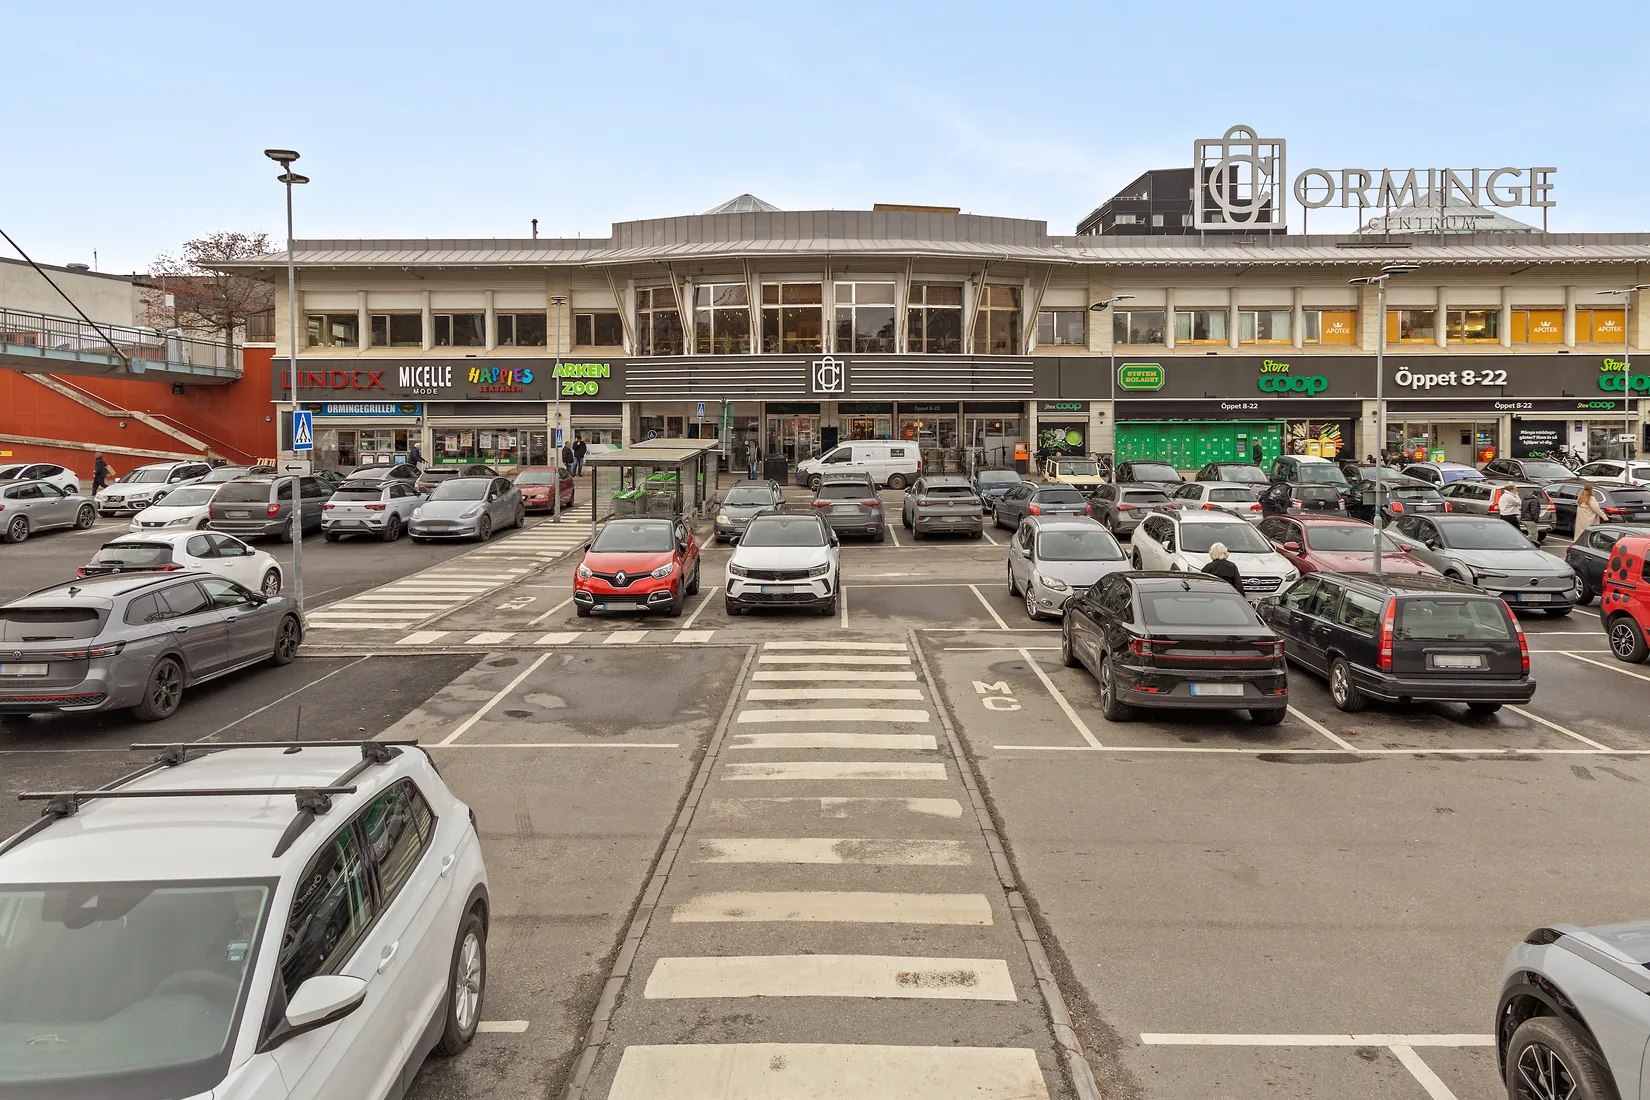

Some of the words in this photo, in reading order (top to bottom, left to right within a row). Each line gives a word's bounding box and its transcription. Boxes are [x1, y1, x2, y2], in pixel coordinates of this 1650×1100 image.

[1293, 166, 1558, 209] ORMINGE
[1368, 216, 1477, 230] CENTRUM
[551, 363, 610, 378] ARKEN
[1260, 359, 1290, 373] Stora
[281, 370, 385, 389] LINDEX
[399, 366, 452, 387] MICELLE
[468, 366, 534, 386] HAPPIES
[1394, 366, 1457, 390] Öppet
[1461, 370, 1508, 386] 8-22
[1598, 374, 1650, 394] coo
[561, 380, 599, 396] ZOO
[1258, 375, 1329, 396] coop
[327, 404, 396, 413] ORMINGEGRILLEN
[1055, 402, 1082, 411] coop
[1220, 402, 1241, 410] Öppet
[1589, 401, 1615, 409] coop
